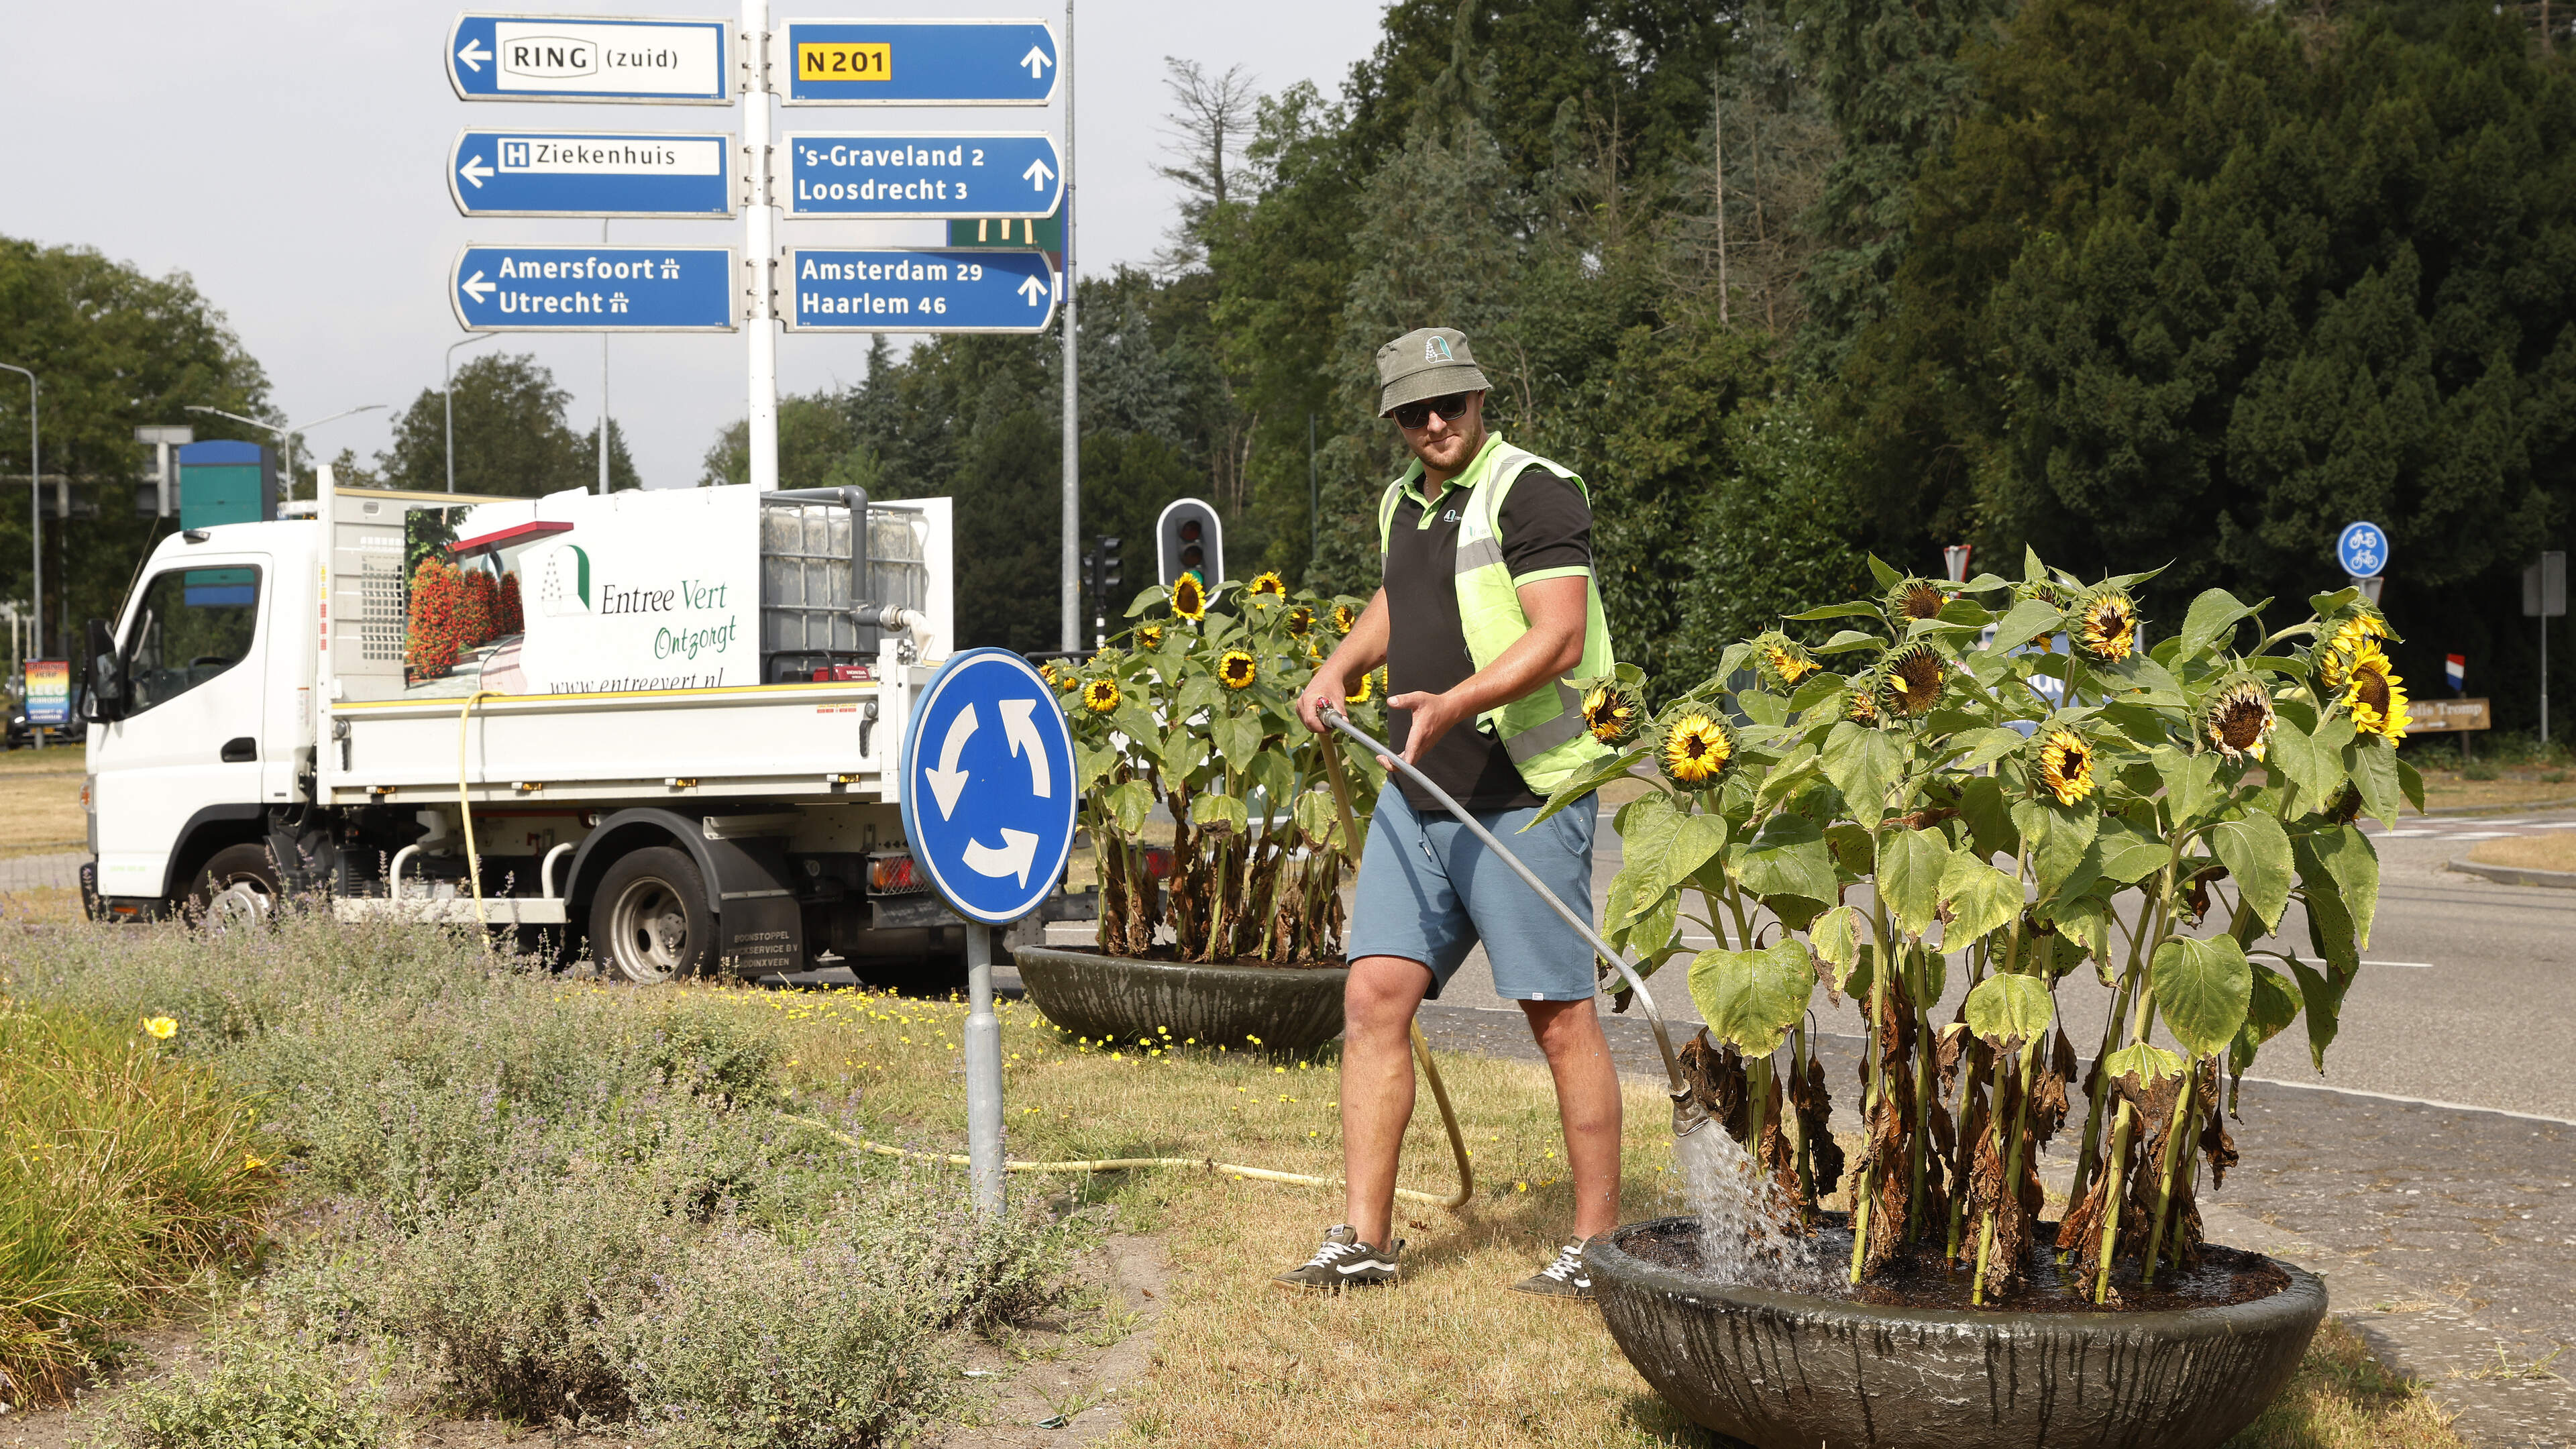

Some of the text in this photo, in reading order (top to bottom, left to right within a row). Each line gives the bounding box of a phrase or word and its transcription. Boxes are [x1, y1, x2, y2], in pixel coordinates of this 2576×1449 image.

[514, 46, 678, 69] RING (zuid)
[806, 52, 883, 72] N201
[536, 144, 676, 165] Ziekenhuis
[799, 145, 985, 166] 's-Graveland 2
[799, 179, 968, 201] Loosdrecht 3
[498, 257, 655, 279] Amersfoort
[801, 259, 983, 282] Amsterdam 29
[499, 291, 603, 314] Utrecht
[802, 292, 947, 314] Haarlem 46
[601, 580, 728, 614] Entree Vert
[655, 615, 737, 660] Ontzorgt
[550, 667, 724, 694] wwwentreevertnl
[735, 931, 790, 943] BOONSTOPPEL
[738, 958, 790, 968] ADDINXVEEN
